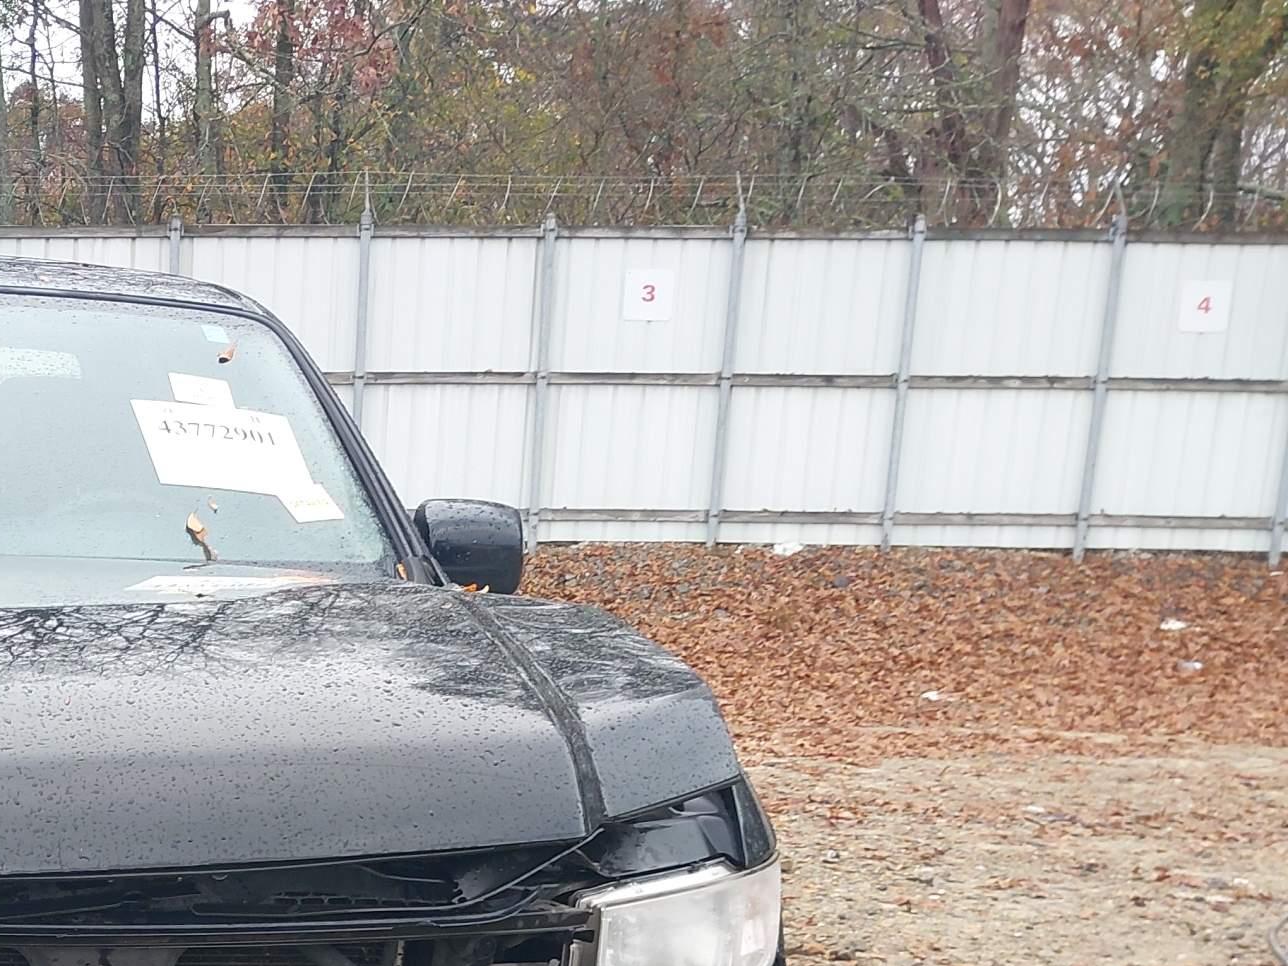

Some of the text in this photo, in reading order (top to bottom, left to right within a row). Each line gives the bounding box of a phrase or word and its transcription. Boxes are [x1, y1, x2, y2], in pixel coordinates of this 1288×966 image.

[641, 284, 656, 303] 3
[1197, 296, 1212, 315] 4
[158, 418, 277, 446] 43772901
